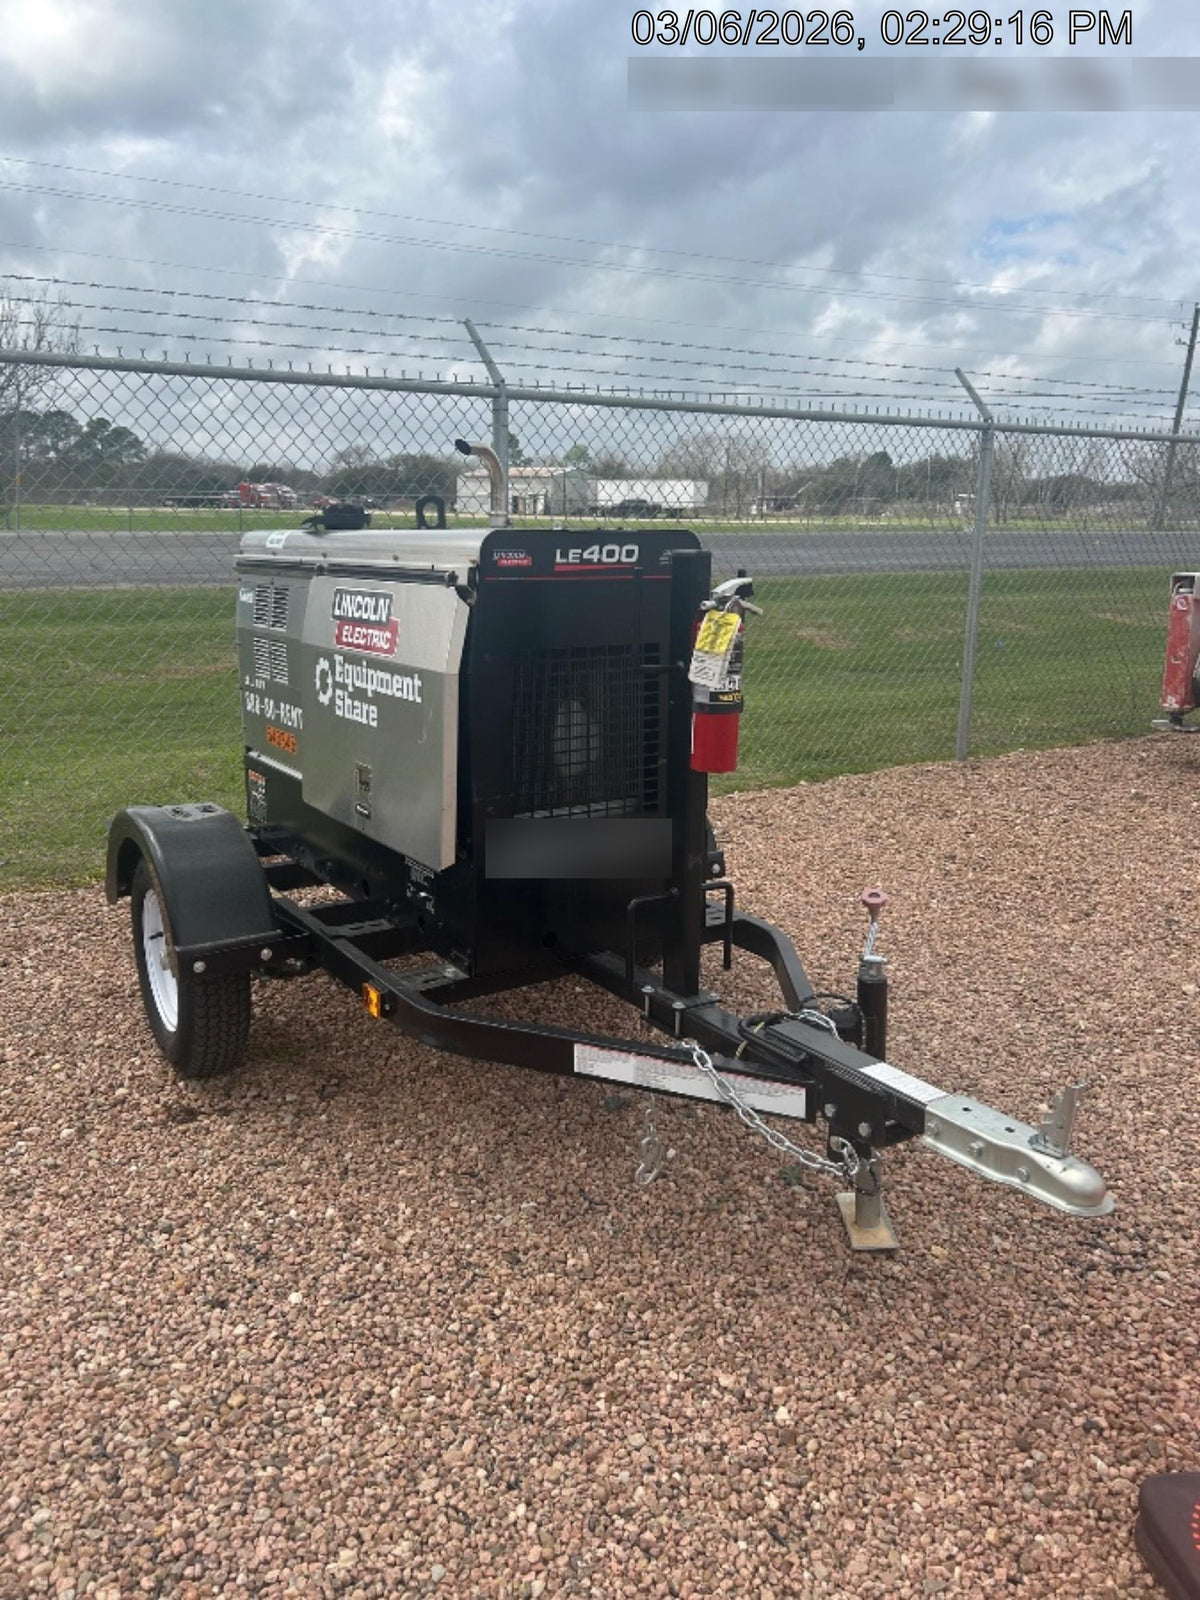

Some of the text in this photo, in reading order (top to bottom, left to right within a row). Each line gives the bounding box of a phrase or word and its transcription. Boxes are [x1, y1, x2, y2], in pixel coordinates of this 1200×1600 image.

[554, 543, 639, 564] LE400
[333, 592, 390, 624] LINCOLN
[341, 624, 393, 649] ELECTRIC
[333, 653, 422, 703] Equipment
[334, 688, 378, 728] Share
